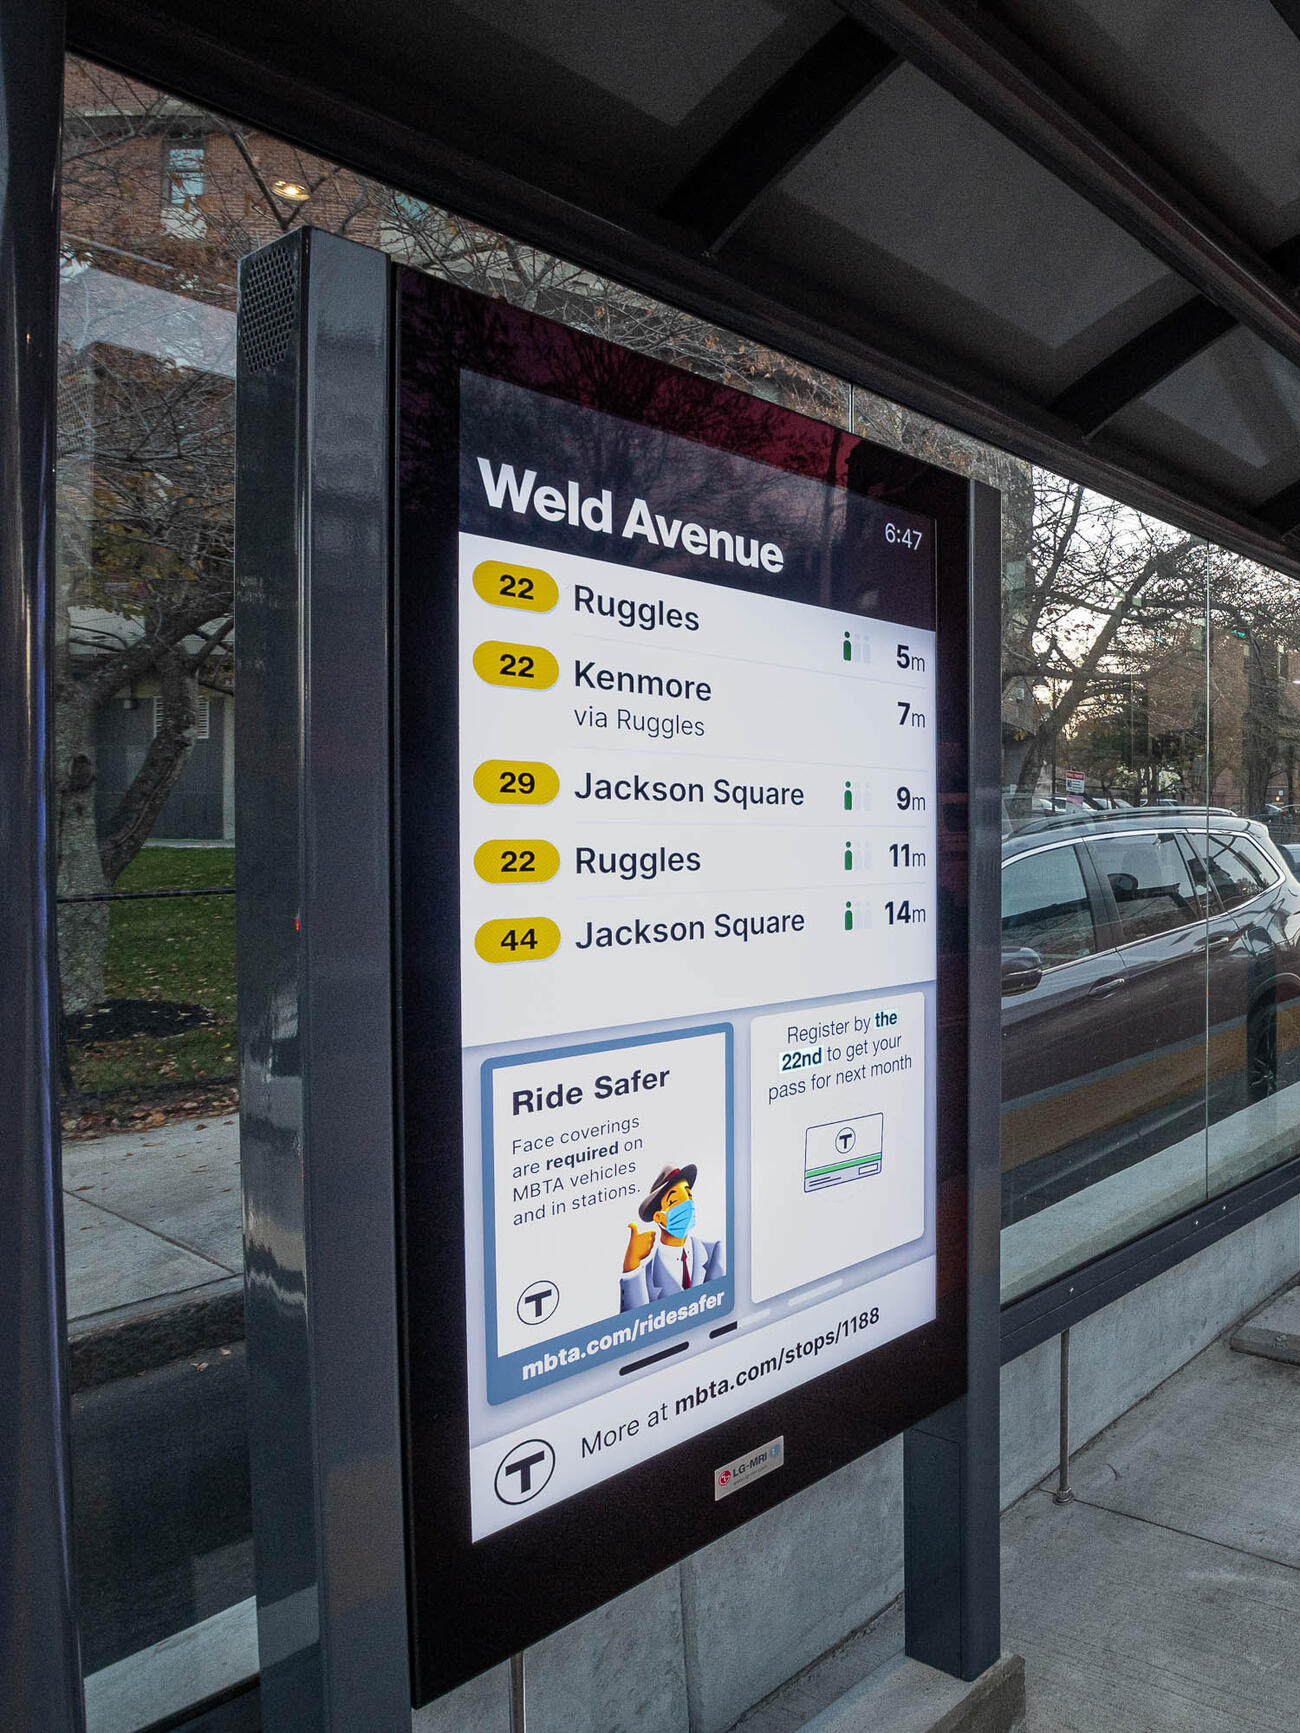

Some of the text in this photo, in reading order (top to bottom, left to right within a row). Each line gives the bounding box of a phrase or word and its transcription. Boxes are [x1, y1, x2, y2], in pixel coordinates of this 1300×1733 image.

[477, 457, 785, 574] Weld Avenue
[885, 523, 922, 551] 6:47
[500, 573, 700, 631] 22 Ruggles
[500, 654, 712, 701] 22 Kenmore
[896, 645, 926, 672] 5m
[574, 707, 705, 739] via Ruggles
[896, 702, 926, 728] 7m
[500, 772, 804, 809] 29 Jackson Square
[896, 787, 926, 811] 9m
[500, 847, 701, 880] 22 Ruggles
[889, 844, 926, 869] 11m
[501, 911, 805, 952] 44 Jackson Square
[885, 901, 926, 926] 14m
[787, 1012, 898, 1045] Register by the
[782, 1034, 902, 1071] 22nd to get your
[512, 1068, 671, 1116] Ride Safer
[768, 1053, 913, 1105] pass for next month
[512, 1115, 640, 1155] Face coverings
[512, 1137, 643, 1179] are required on
[512, 1160, 636, 1202] MBTA vehicles
[512, 1180, 641, 1226] and in stations.
[522, 1288, 726, 1381] mbta.com/ridesafer
[580, 1306, 881, 1459] More at mbta.com/stops/1188
[504, 1449, 546, 1494] T
[732, 1451, 768, 1477] LG-MRI
